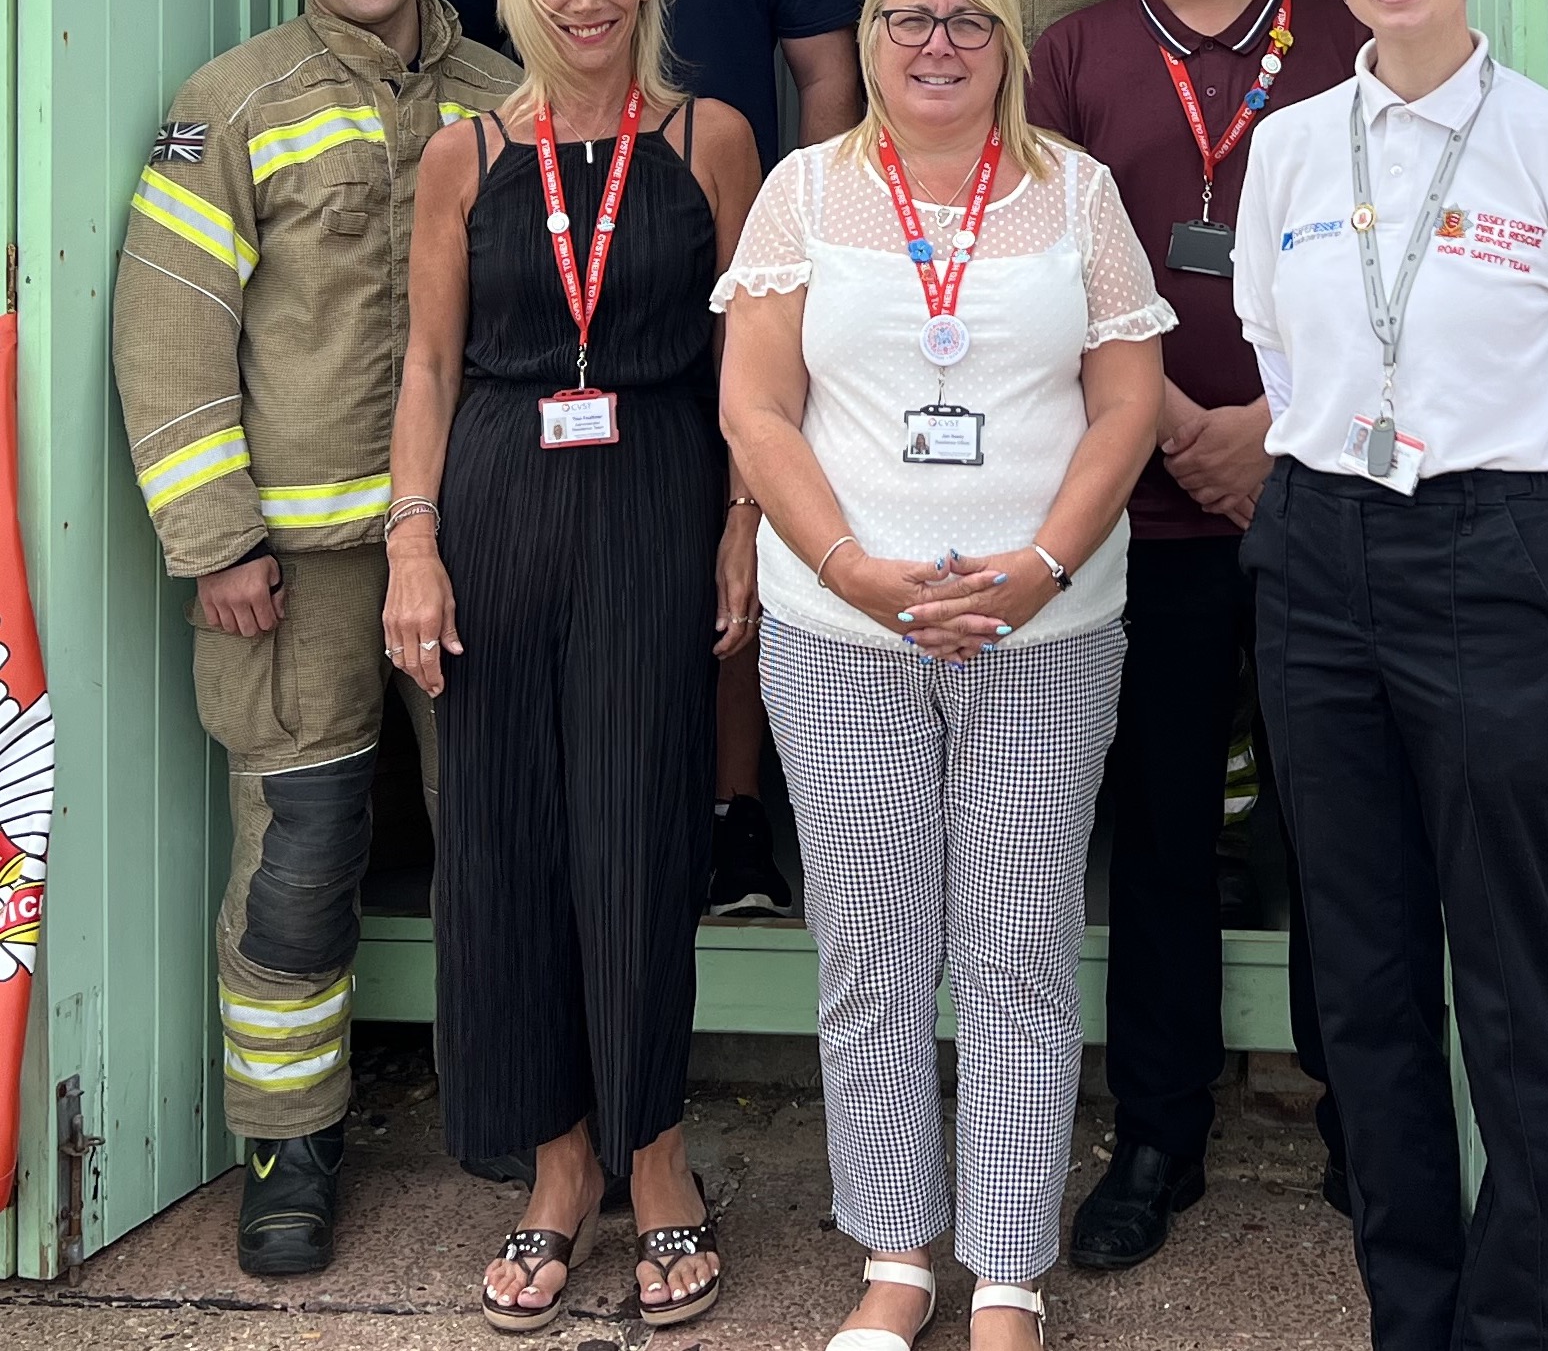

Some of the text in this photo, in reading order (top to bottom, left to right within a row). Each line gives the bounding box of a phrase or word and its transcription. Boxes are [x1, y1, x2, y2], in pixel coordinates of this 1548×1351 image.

[1179, 81, 1192, 101] CVST
[1187, 101, 1200, 123] HERE
[1195, 123, 1203, 135] TO
[1214, 107, 1252, 159] CVST HERE TO
[544, 159, 554, 171] TO
[605, 134, 630, 214] CVST HERE TO HELP
[546, 170, 557, 195] HERE
[550, 195, 560, 213] VST
[886, 164, 918, 236] CVST HERE TO HELP
[965, 162, 991, 231] VST HERE TO HELP
[1475, 223, 1542, 248] FIRE & RESCUE
[1477, 213, 1547, 236] ESSEX COUNTY
[594, 234, 606, 257] CVST
[1474, 234, 1512, 250] SERVICE
[562, 258, 571, 271] TO
[589, 257, 600, 283] HERE
[1437, 245, 1531, 273] ROAD SAFETY TEAM
[565, 271, 577, 297] HERE
[948, 272, 958, 283] TO
[588, 284, 597, 297] TO
[942, 283, 955, 308] HERE
